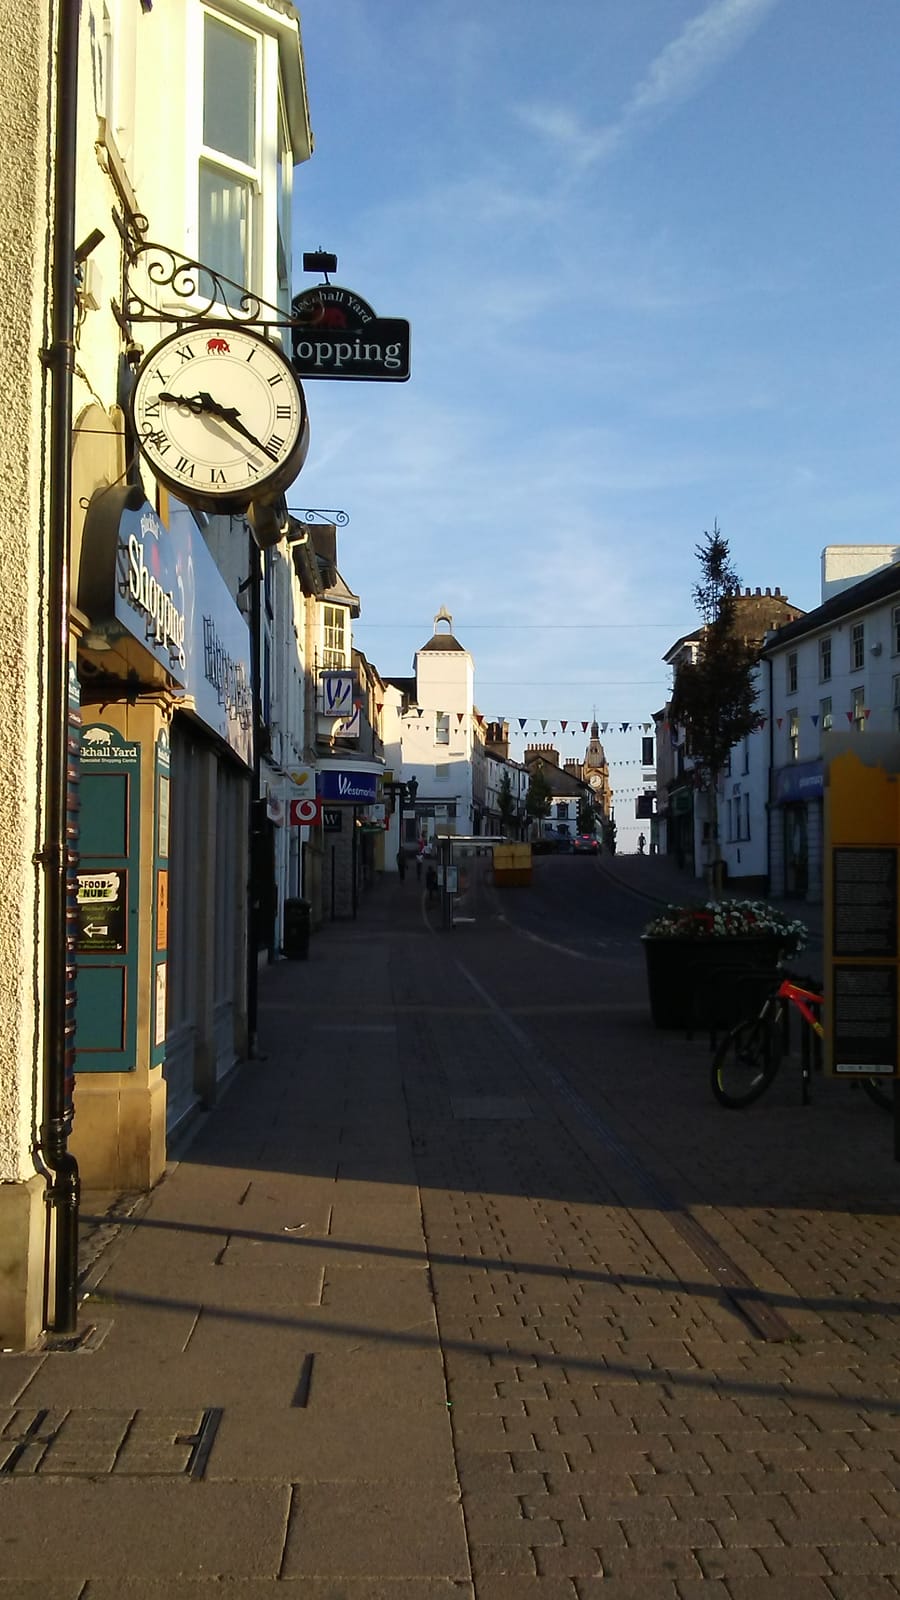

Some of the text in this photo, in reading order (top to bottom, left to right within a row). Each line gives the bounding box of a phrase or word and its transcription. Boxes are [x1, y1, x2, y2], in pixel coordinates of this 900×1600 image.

[347, 295, 373, 324] Yard
[292, 338, 402, 368] opping
[128, 533, 186, 671] Shopping
[80, 746, 137, 757] khall Yard
[84, 880, 107, 889] FOOD
